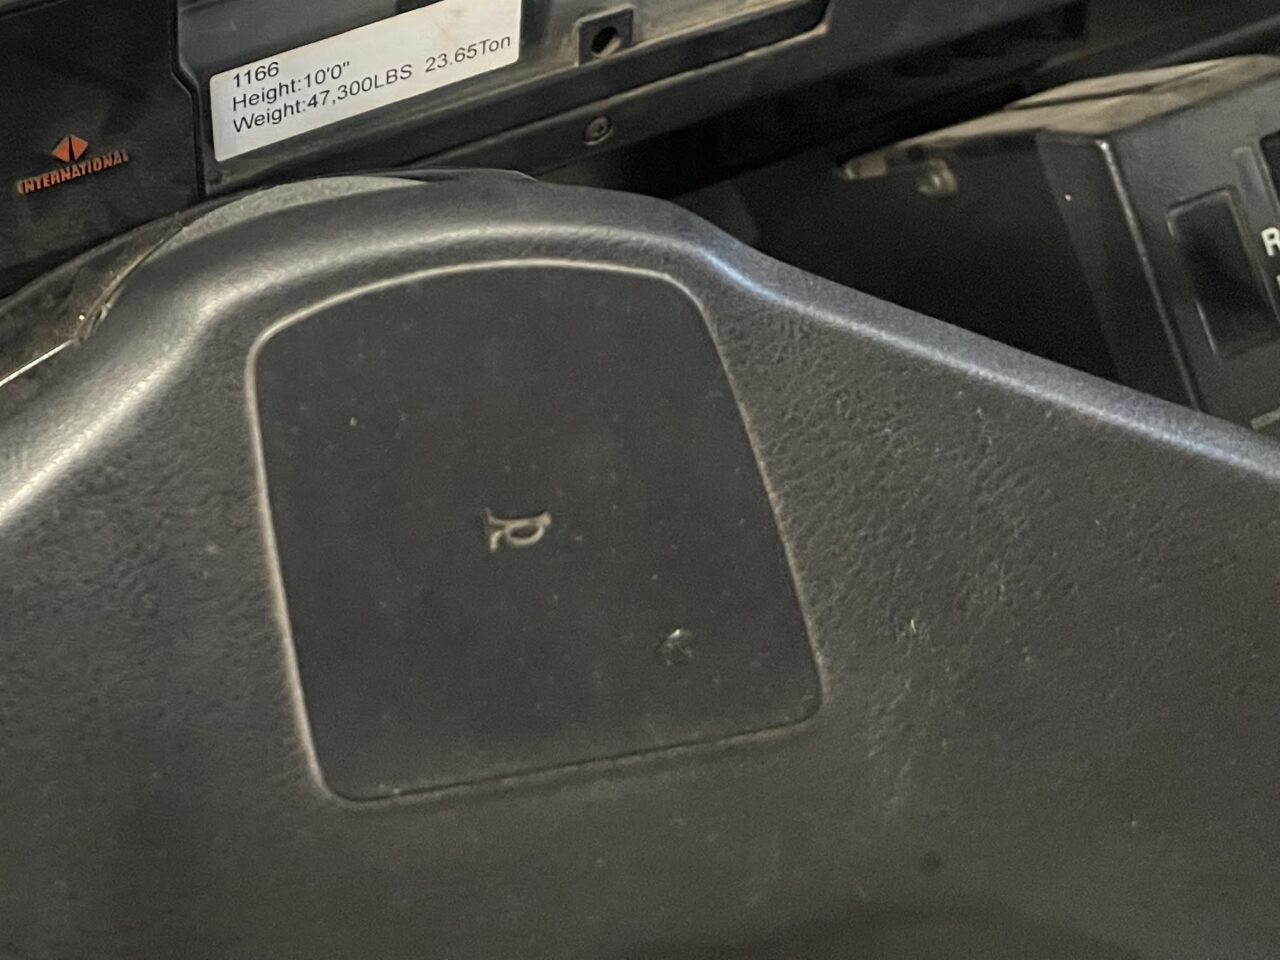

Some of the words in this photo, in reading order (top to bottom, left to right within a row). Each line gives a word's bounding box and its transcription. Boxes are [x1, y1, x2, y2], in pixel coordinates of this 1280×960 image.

[232, 61, 281, 88] 1166
[232, 64, 413, 133] Weight:47,300LBS
[424, 36, 512, 73] 23.65Ton
